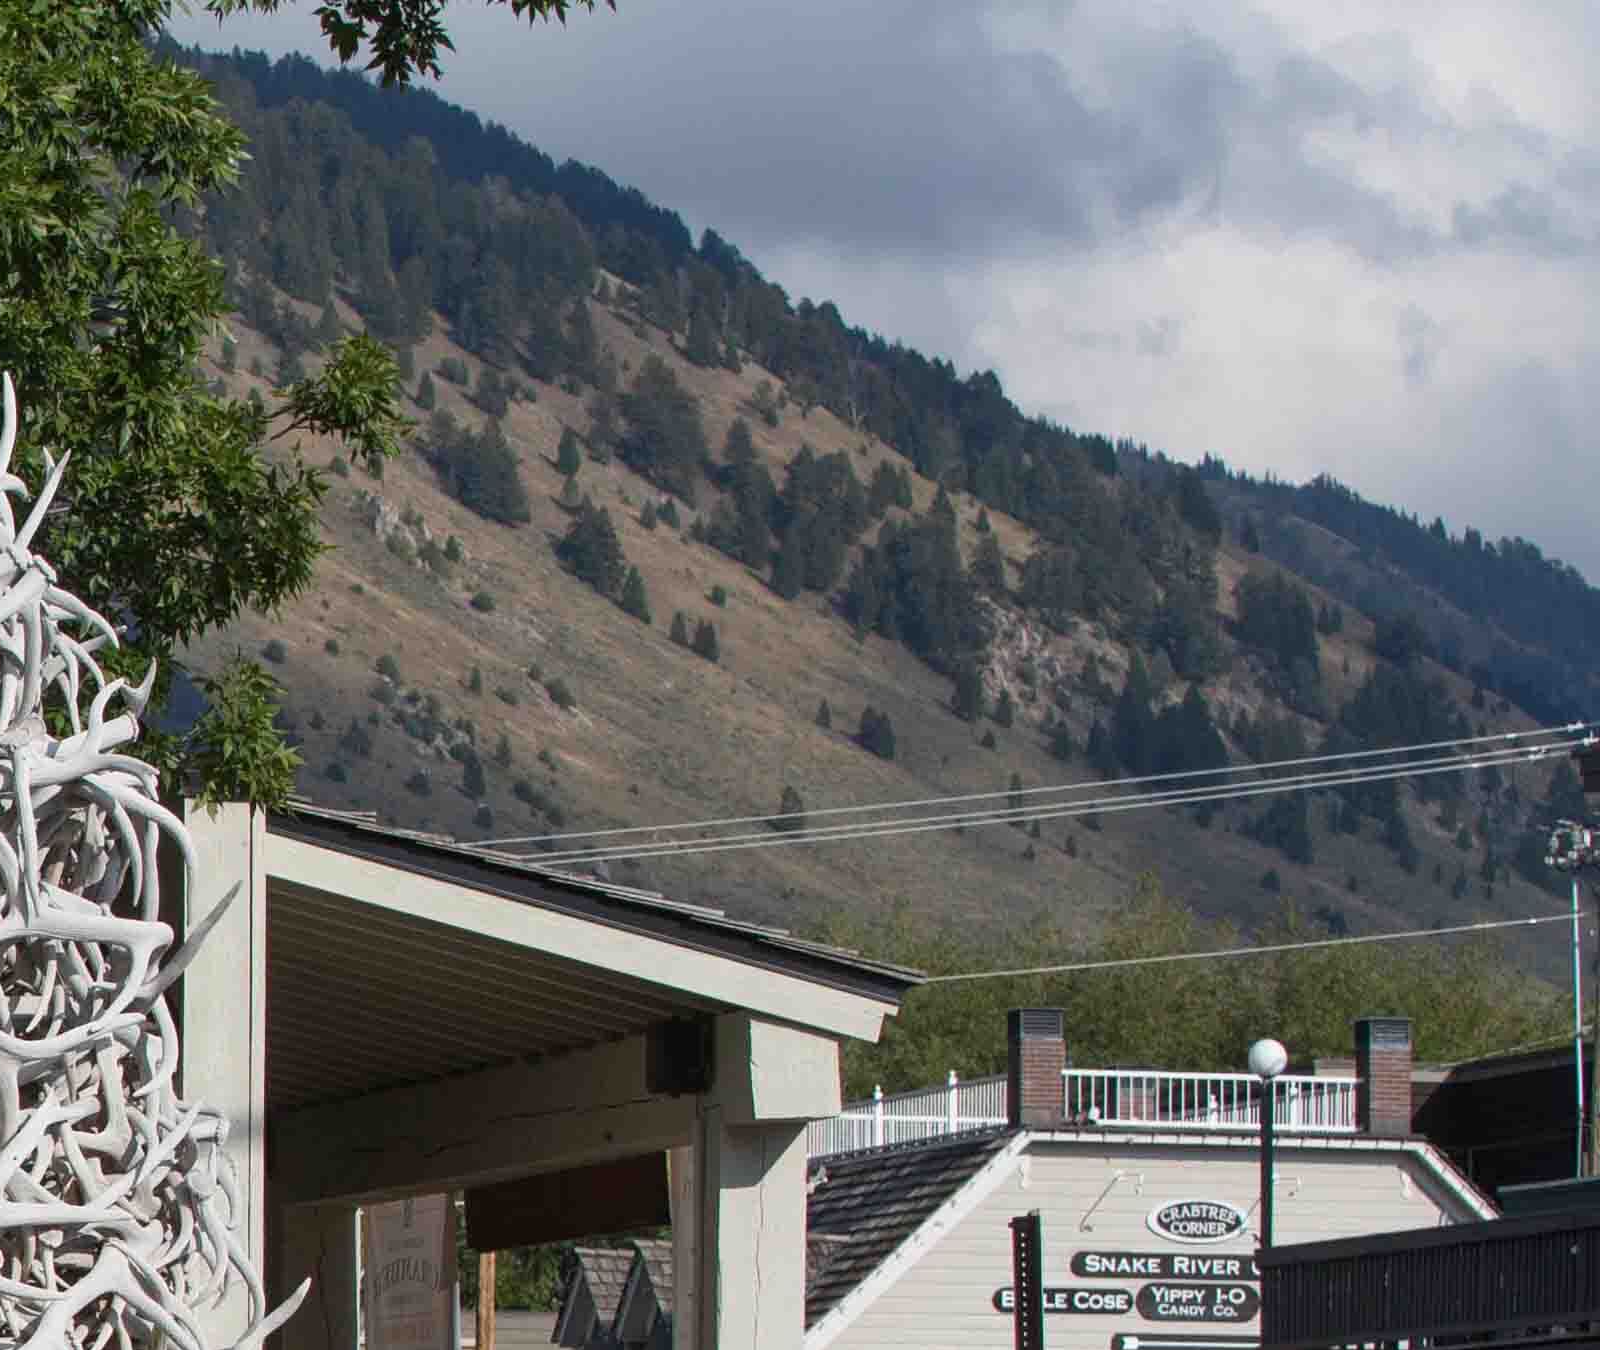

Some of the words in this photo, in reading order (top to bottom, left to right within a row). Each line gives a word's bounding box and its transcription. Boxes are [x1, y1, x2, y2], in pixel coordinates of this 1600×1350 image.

[1159, 1204, 1238, 1225] CRABTREE
[1170, 1221, 1228, 1237] CORNER
[1085, 1255, 1161, 1274] SNAKE
[1172, 1256, 1240, 1276] RIVER
[1001, 1291, 1068, 1309] BLE
[1073, 1291, 1129, 1310] COSE
[1150, 1286, 1205, 1303] YIPPY
[1157, 1303, 1206, 1317] CANDY
